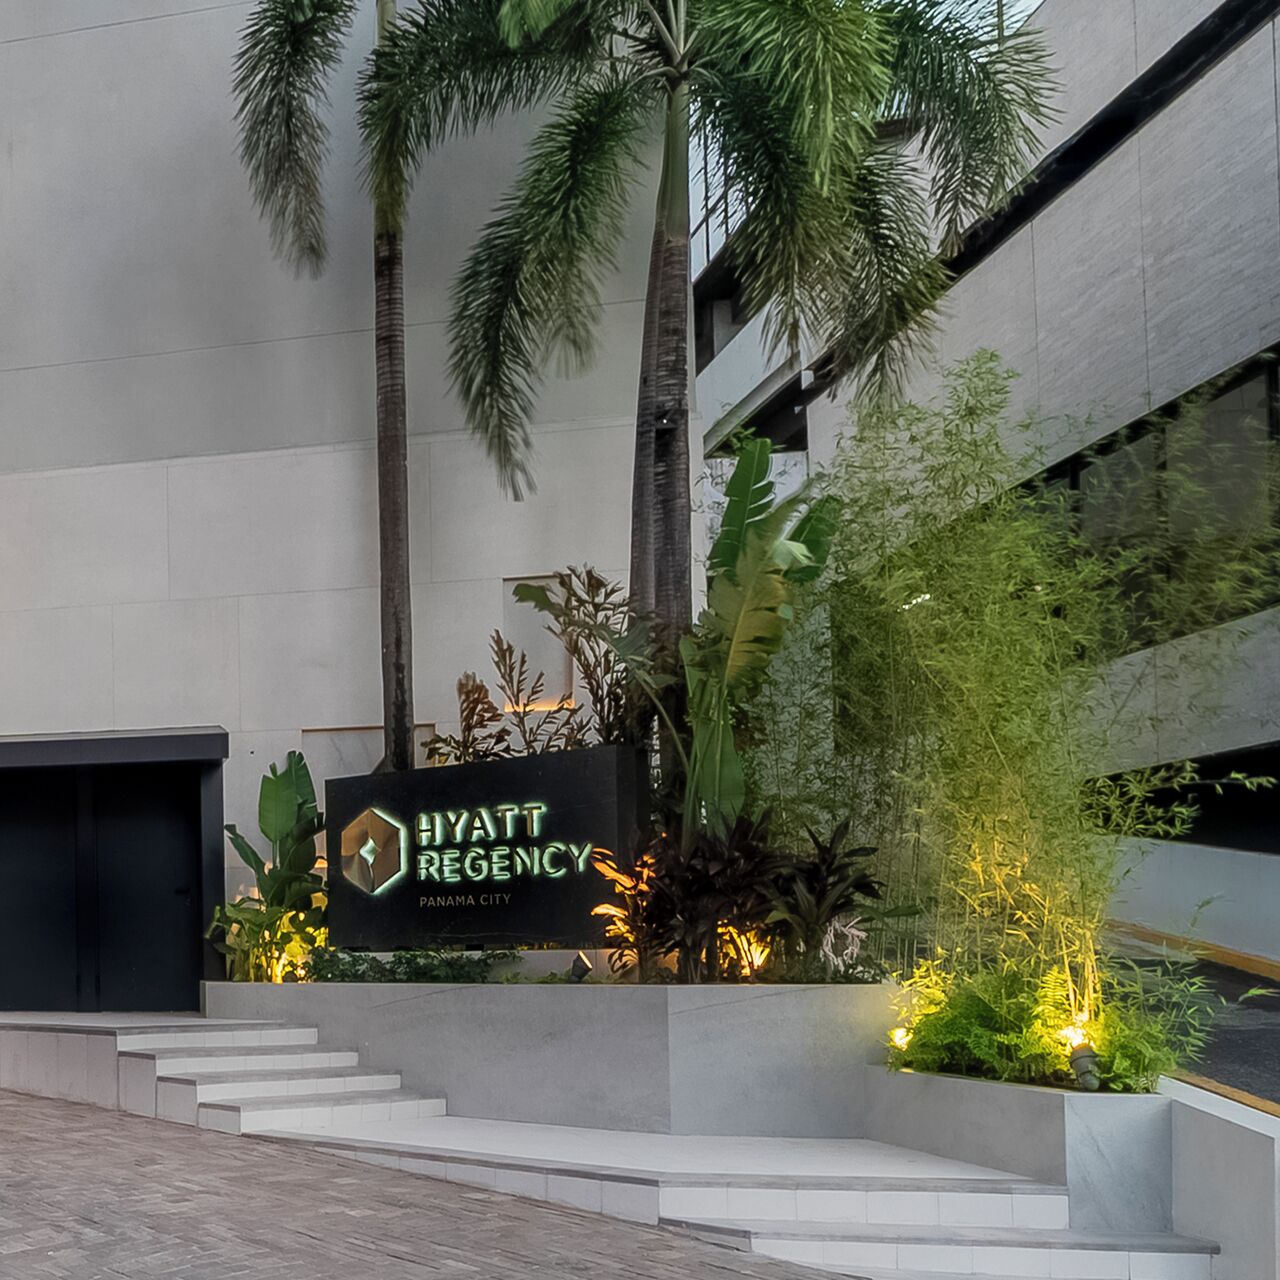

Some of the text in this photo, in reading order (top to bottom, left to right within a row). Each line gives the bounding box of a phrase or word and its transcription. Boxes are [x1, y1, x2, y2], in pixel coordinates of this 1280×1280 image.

[416, 802, 547, 846] HYATT
[416, 842, 592, 882] REGENCY
[419, 893, 512, 908] PANAMA CITY
